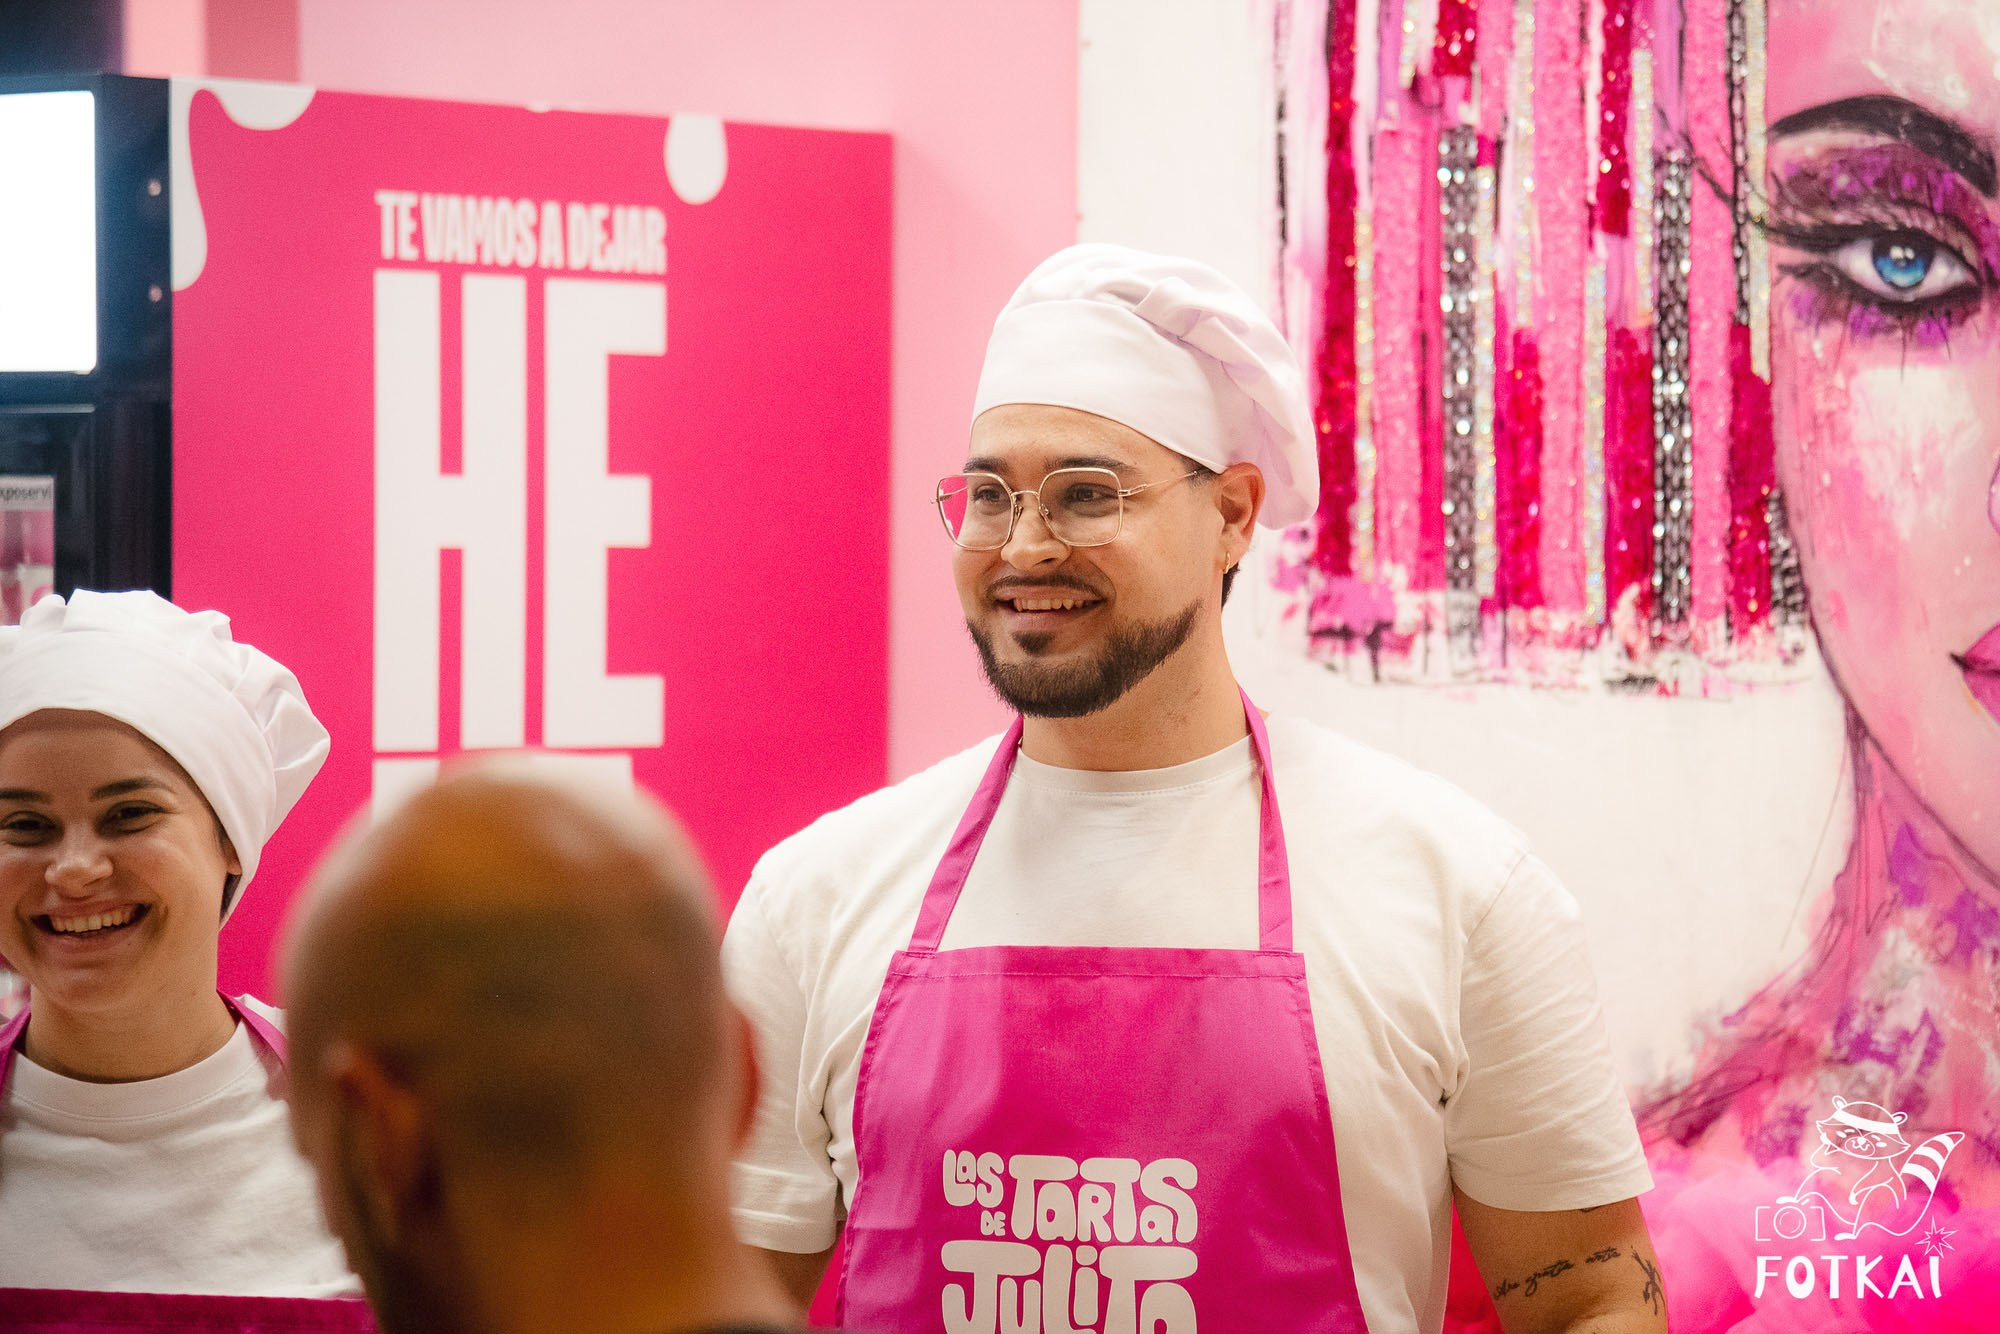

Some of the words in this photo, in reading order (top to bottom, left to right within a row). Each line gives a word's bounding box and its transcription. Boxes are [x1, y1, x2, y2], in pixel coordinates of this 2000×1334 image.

[374, 190, 418, 261] TE
[420, 193, 538, 268] VAMOS
[538, 202, 566, 270] A
[566, 203, 668, 275] DEJAR
[373, 268, 668, 753] HE
[980, 1210, 1006, 1236] DE
